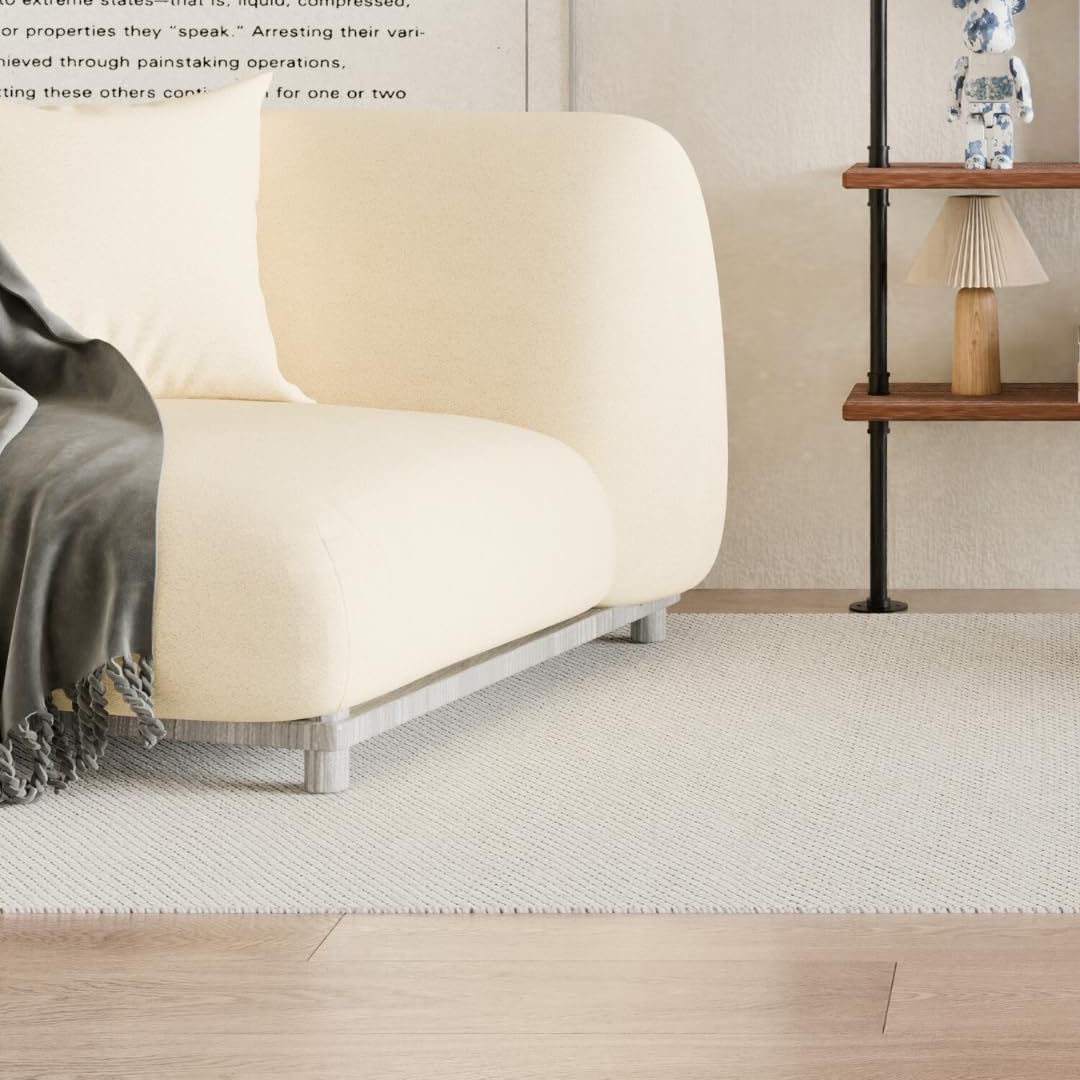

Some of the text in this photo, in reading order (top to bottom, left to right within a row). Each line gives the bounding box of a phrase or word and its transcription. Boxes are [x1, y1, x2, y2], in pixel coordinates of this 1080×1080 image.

[2, 27, 18, 37] or
[26, 25, 116, 39] properties
[124, 25, 162, 39] they
[252, 25, 333, 41] Arresting
[340, 26, 380, 38] their
[387, 27, 425, 39] vari-
